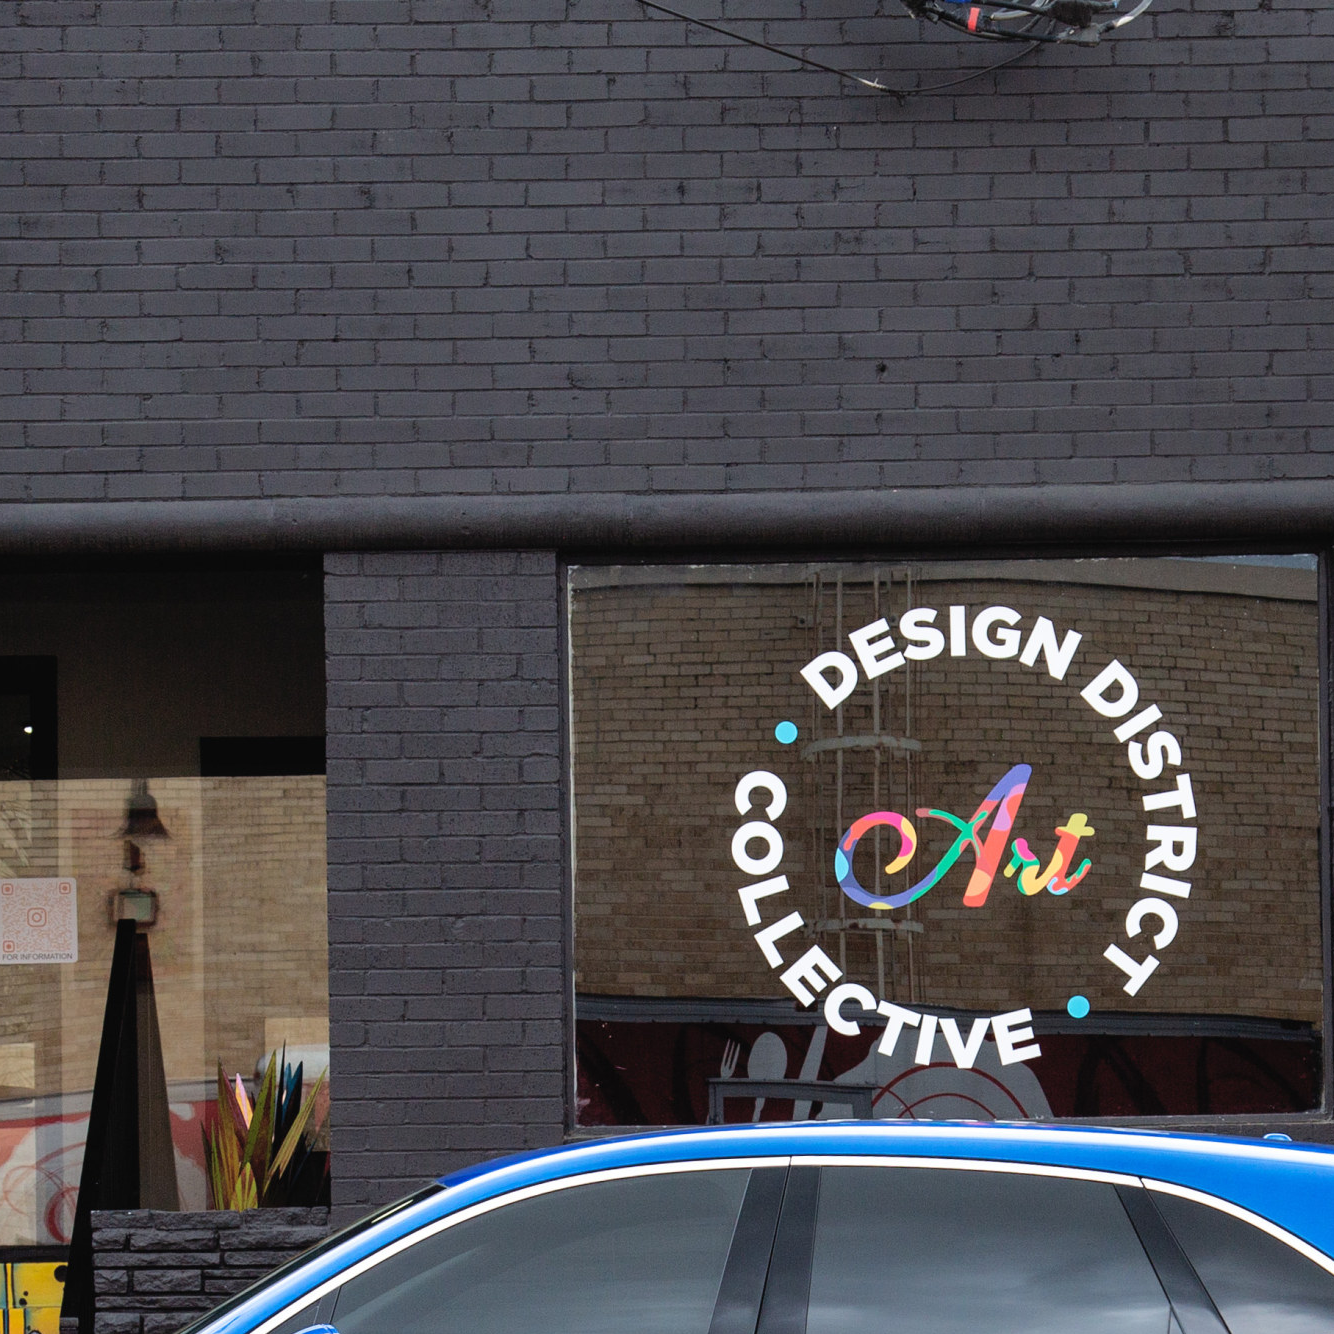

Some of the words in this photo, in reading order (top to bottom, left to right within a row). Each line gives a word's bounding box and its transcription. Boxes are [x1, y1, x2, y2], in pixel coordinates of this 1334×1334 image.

[799, 605, 1083, 710] DESIGN
[1080, 659, 1198, 997] DISTRICT
[834, 763, 1096, 910] Art
[20, 952, 73, 960] INFORMATION
[731, 770, 1042, 1069] COLLECTIVE
